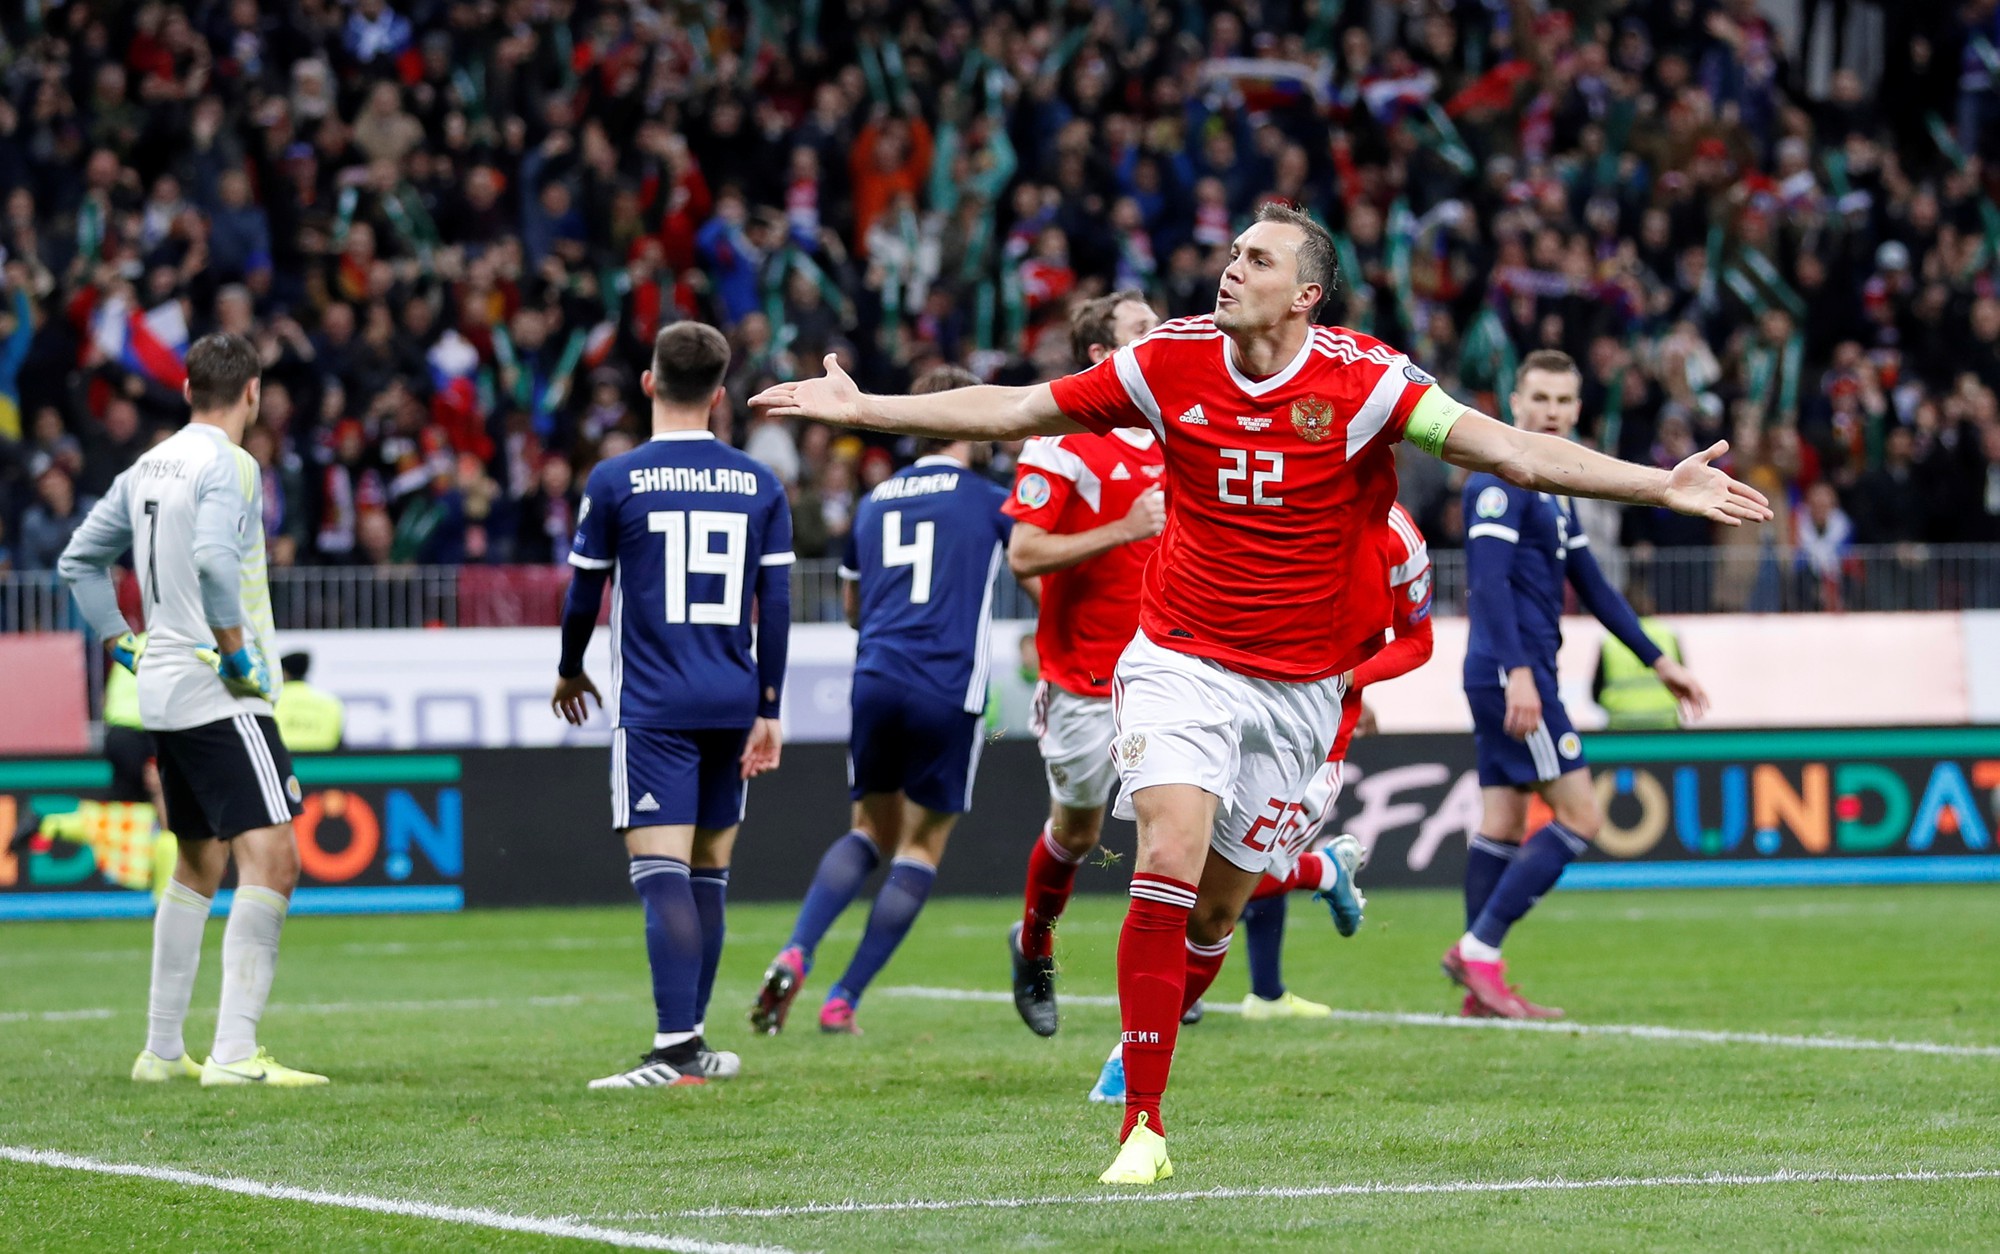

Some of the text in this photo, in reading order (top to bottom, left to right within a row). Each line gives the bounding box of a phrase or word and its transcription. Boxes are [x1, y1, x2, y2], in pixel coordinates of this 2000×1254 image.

[1179, 415, 1209, 426] adidas
[629, 467, 758, 496] SHANKLAND
[1218, 448, 1284, 506] 22
[144, 500, 161, 604] 1
[647, 510, 749, 626] 19
[882, 510, 935, 604] 4
